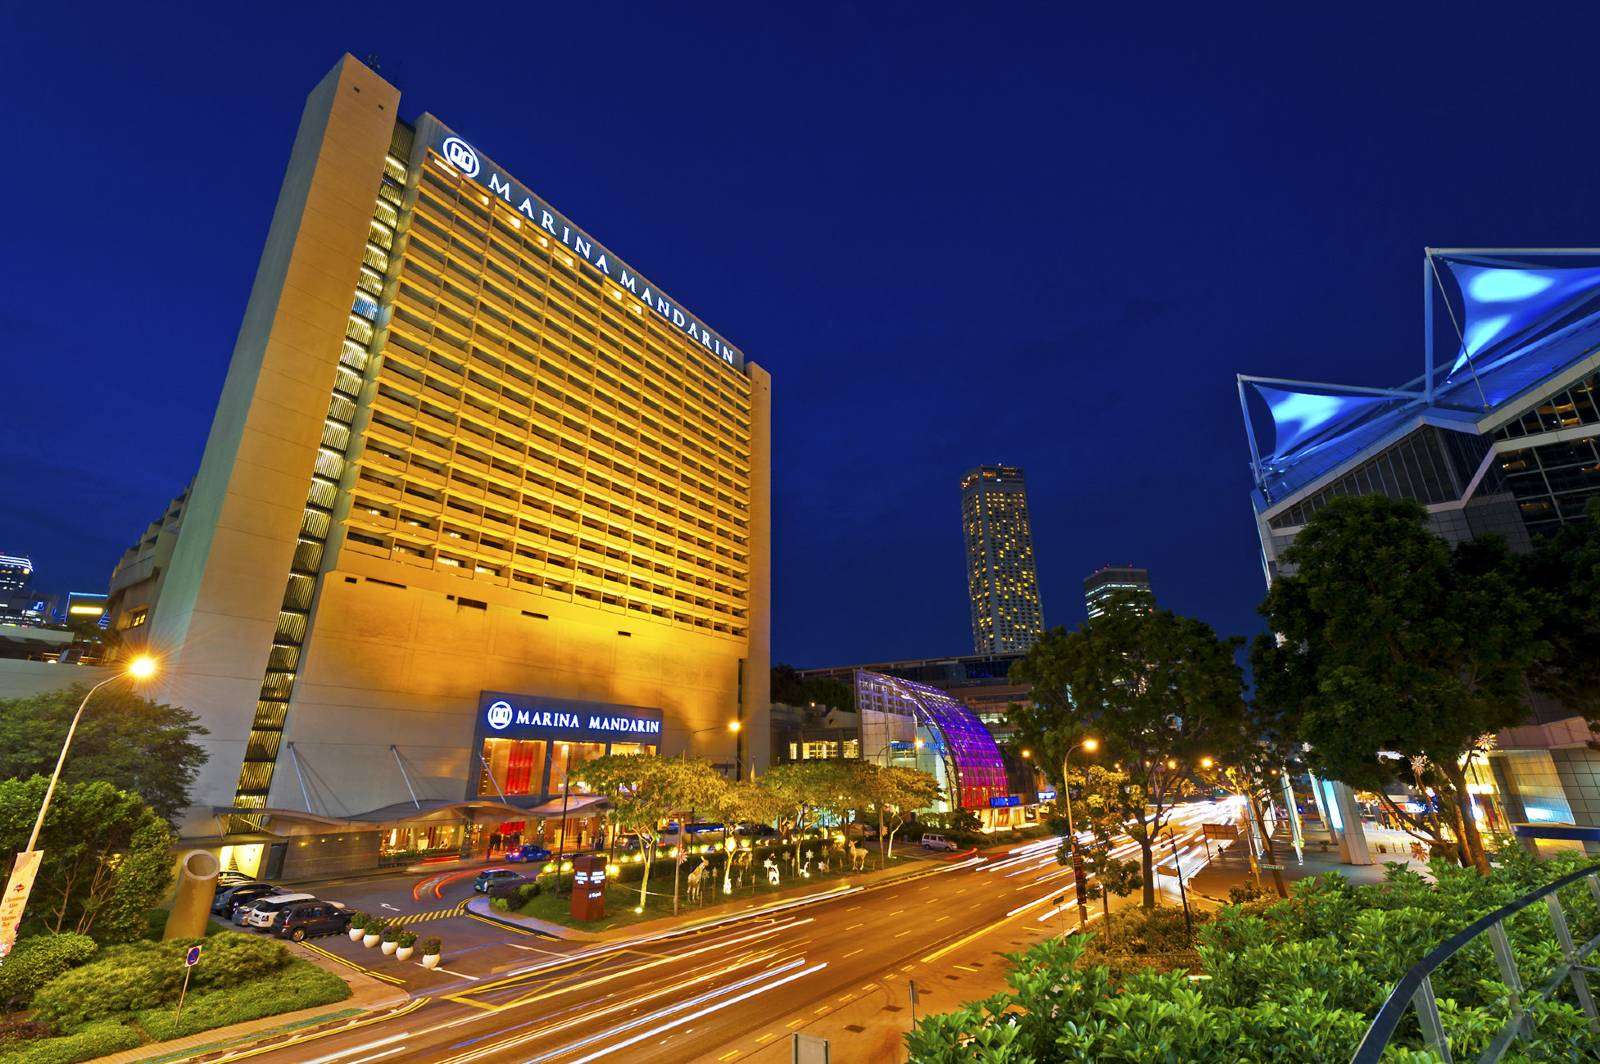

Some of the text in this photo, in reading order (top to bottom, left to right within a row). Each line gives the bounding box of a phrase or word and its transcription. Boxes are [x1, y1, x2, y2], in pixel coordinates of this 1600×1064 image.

[487, 173, 734, 364] MARINA MANDARIN
[515, 710, 660, 733] MARINA MANDARIN
